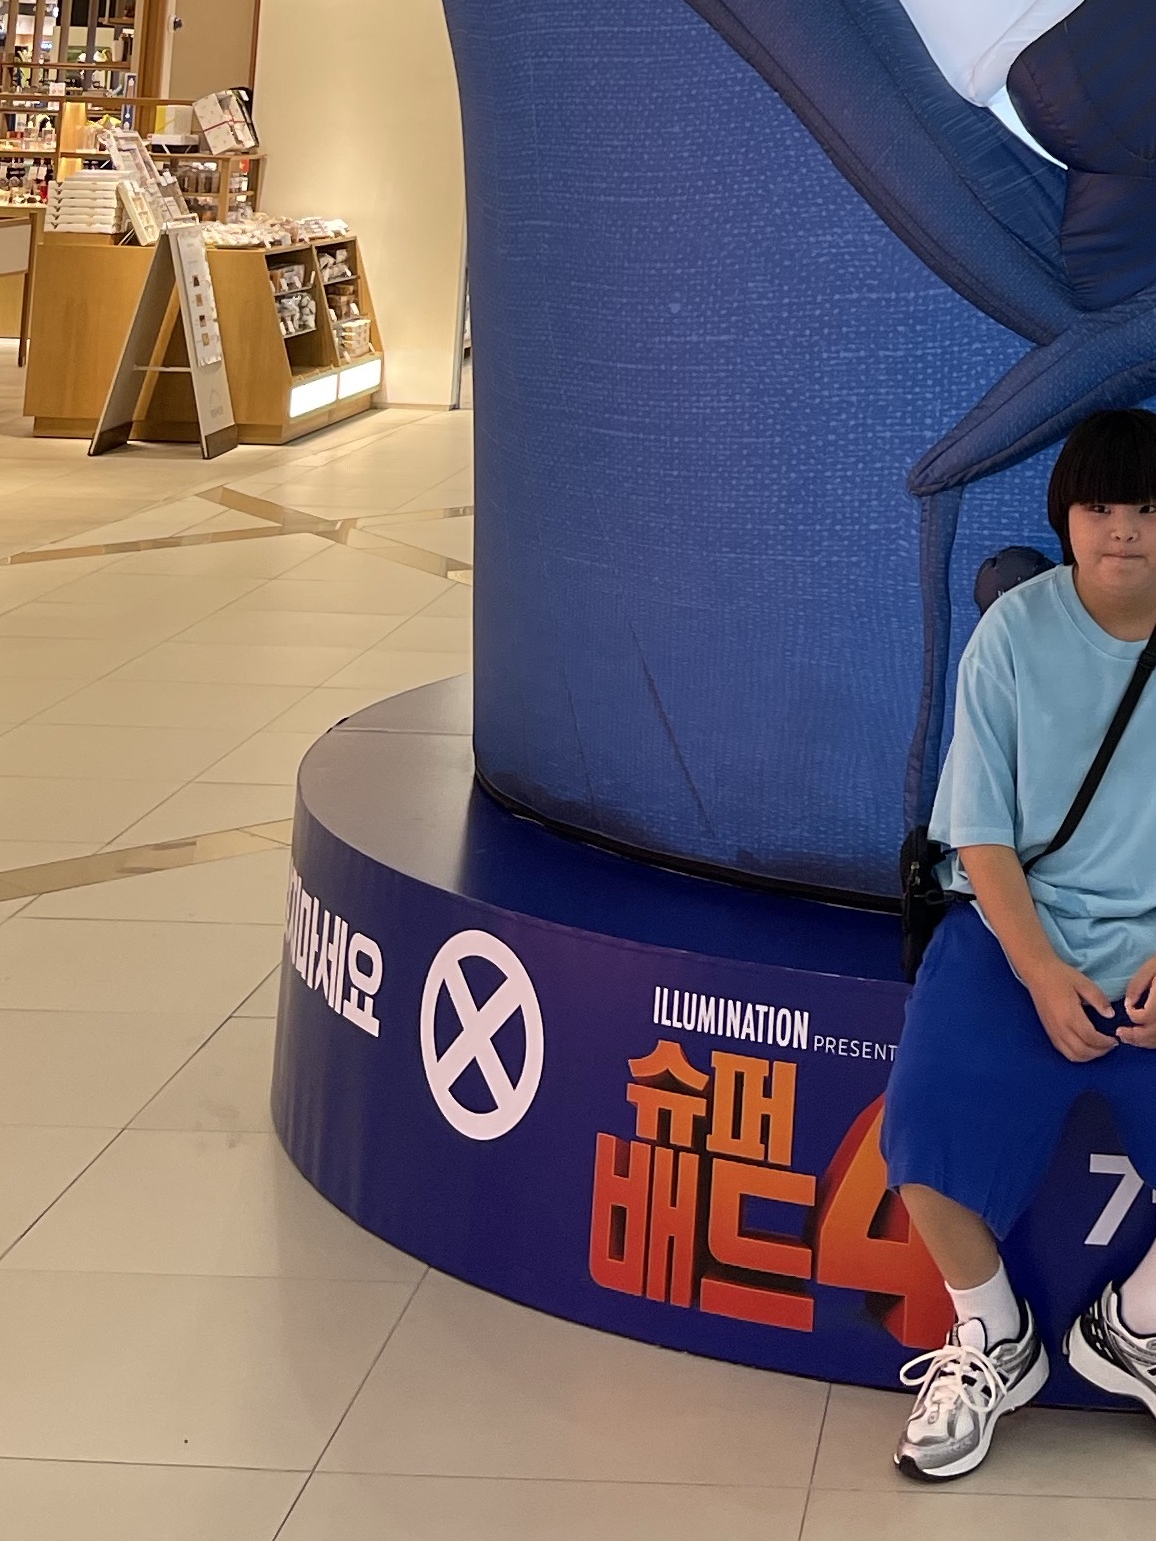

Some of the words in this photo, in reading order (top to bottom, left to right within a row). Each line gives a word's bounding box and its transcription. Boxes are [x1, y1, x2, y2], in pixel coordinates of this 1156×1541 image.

[653, 986, 810, 1050] ILLUMINATION
[627, 1040, 798, 1167] 슈퍼
[589, 1132, 817, 1333] 배드
